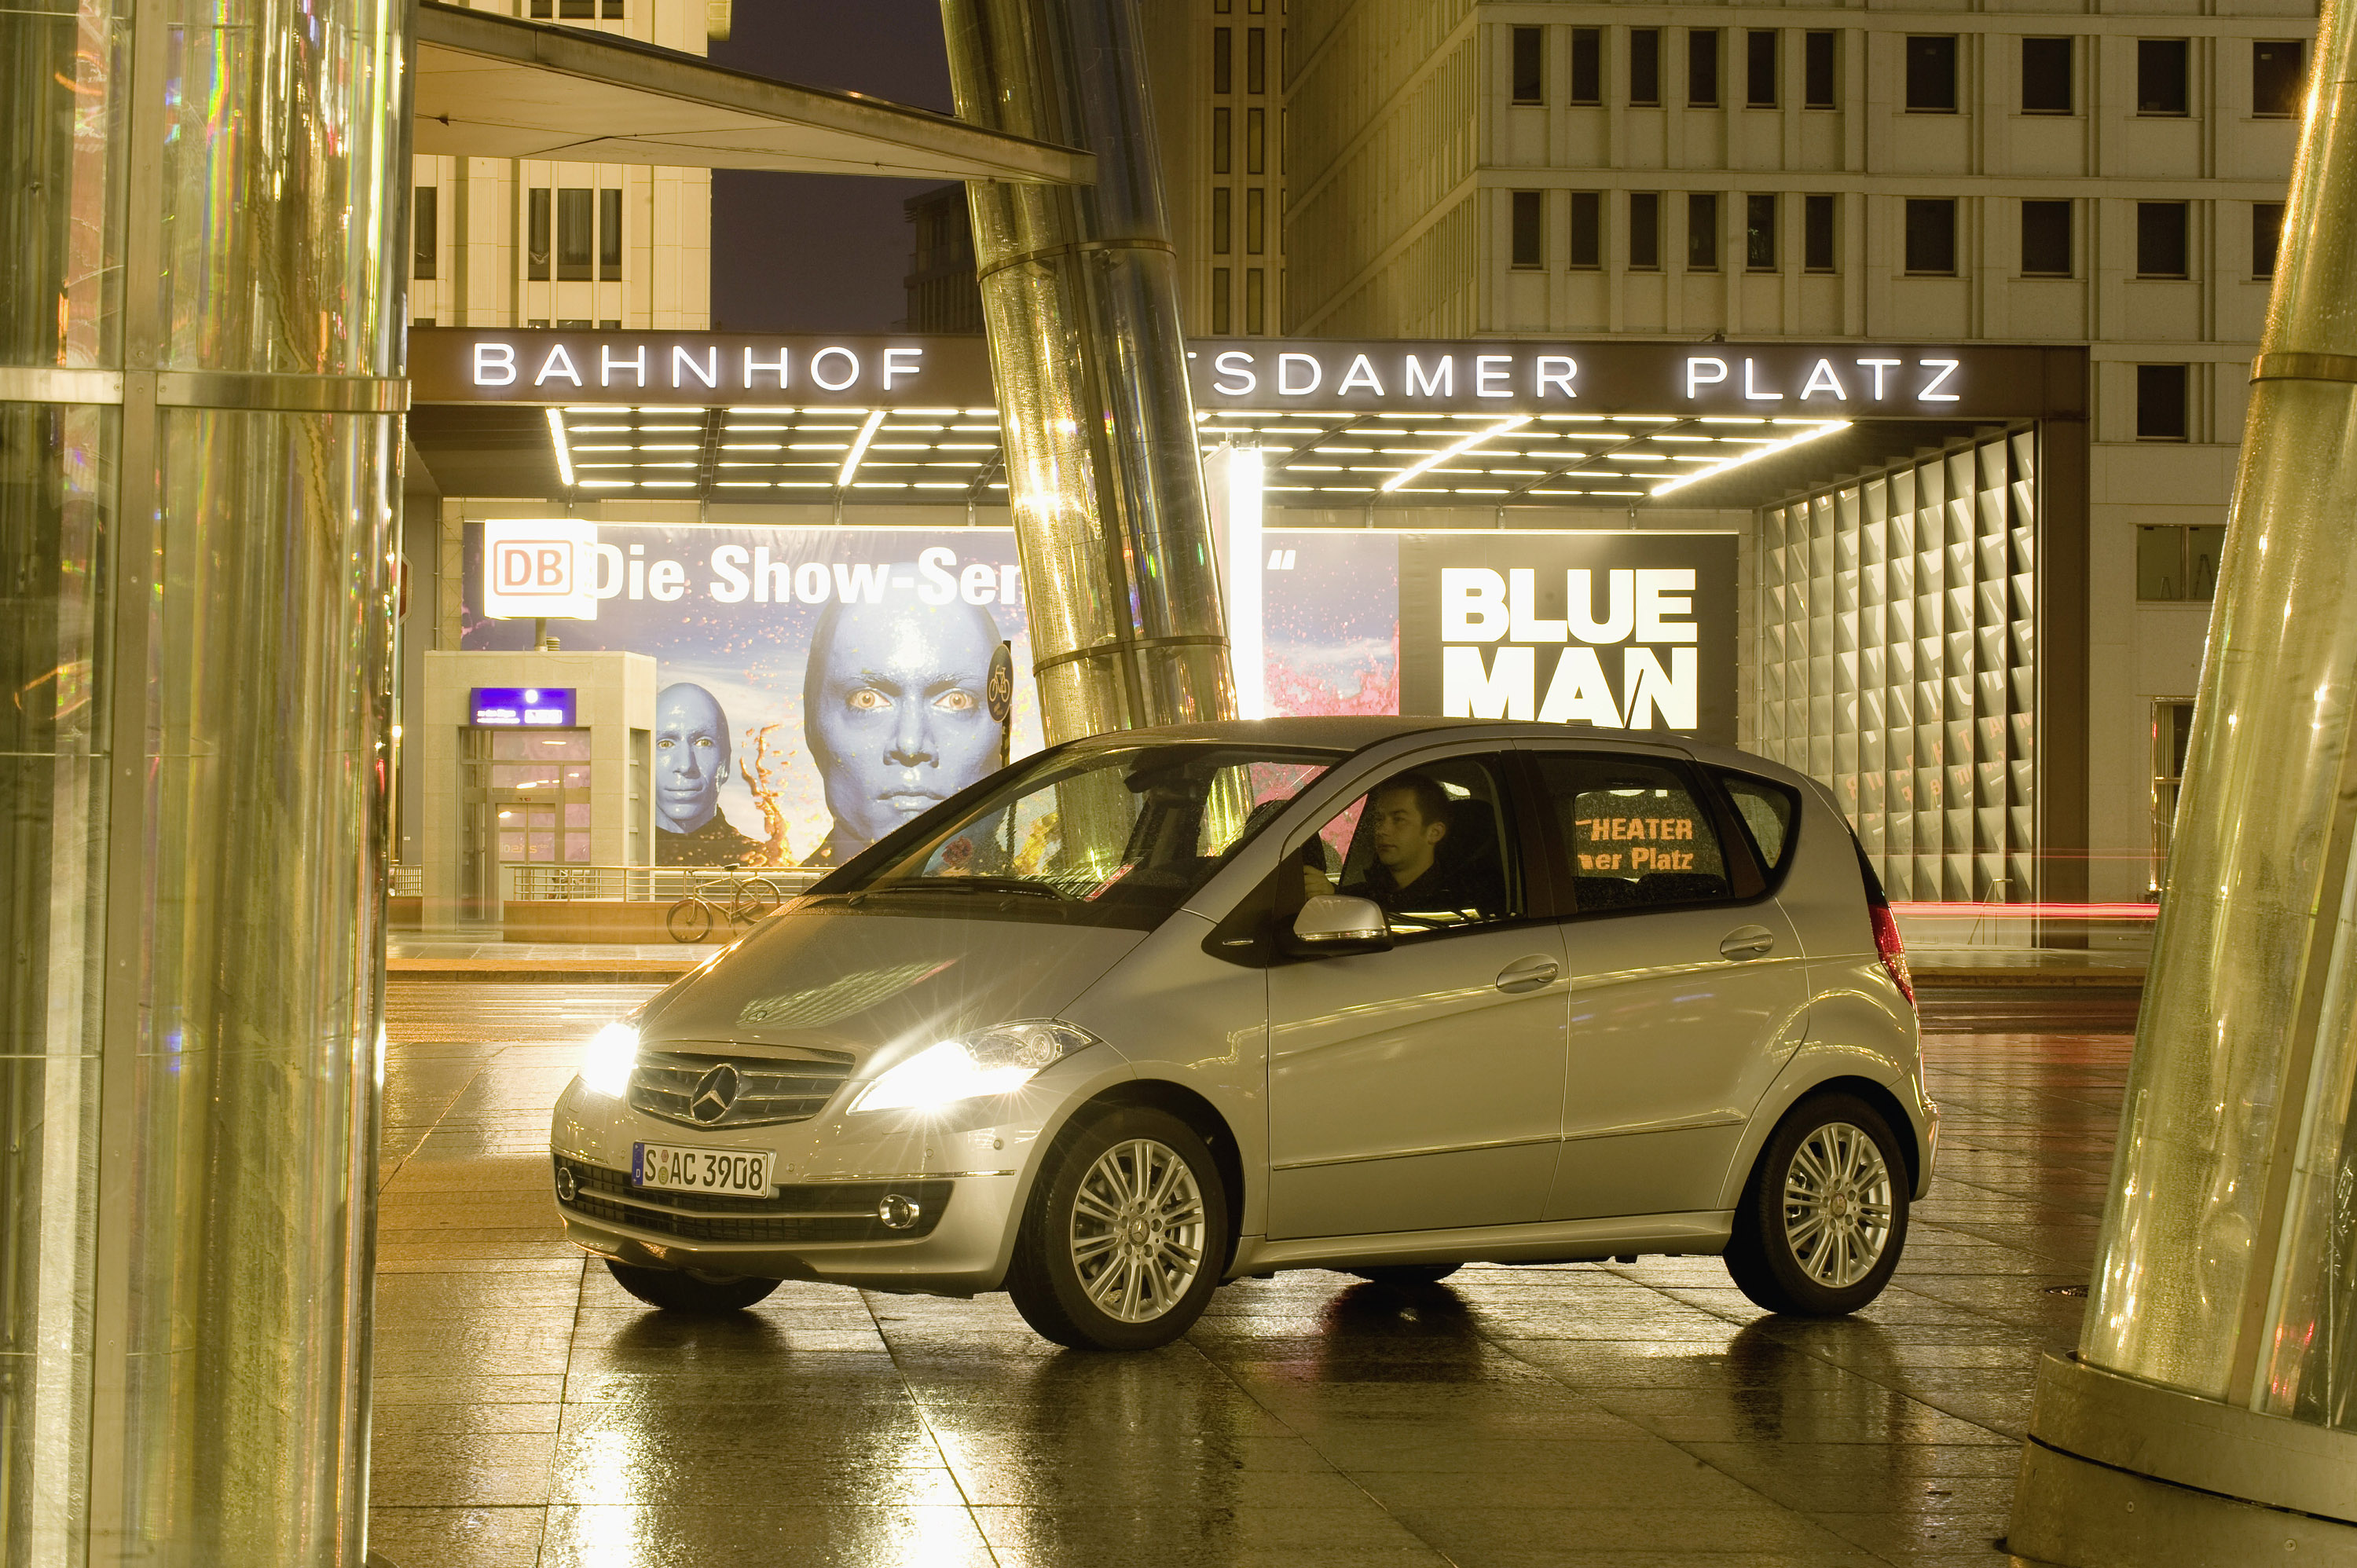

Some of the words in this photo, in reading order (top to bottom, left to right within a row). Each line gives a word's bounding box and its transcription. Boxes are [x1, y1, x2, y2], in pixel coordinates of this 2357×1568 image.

[474, 343, 923, 391] BAHNHOF
[1187, 351, 1578, 397] SDAMER
[1687, 357, 1960, 401] PLATZ
[504, 549, 564, 586] DB
[1441, 567, 1698, 644] BLUE
[1442, 646, 1698, 730] MAN
[1631, 847, 1694, 870] Platz
[702, 1154, 763, 1191] 3908
